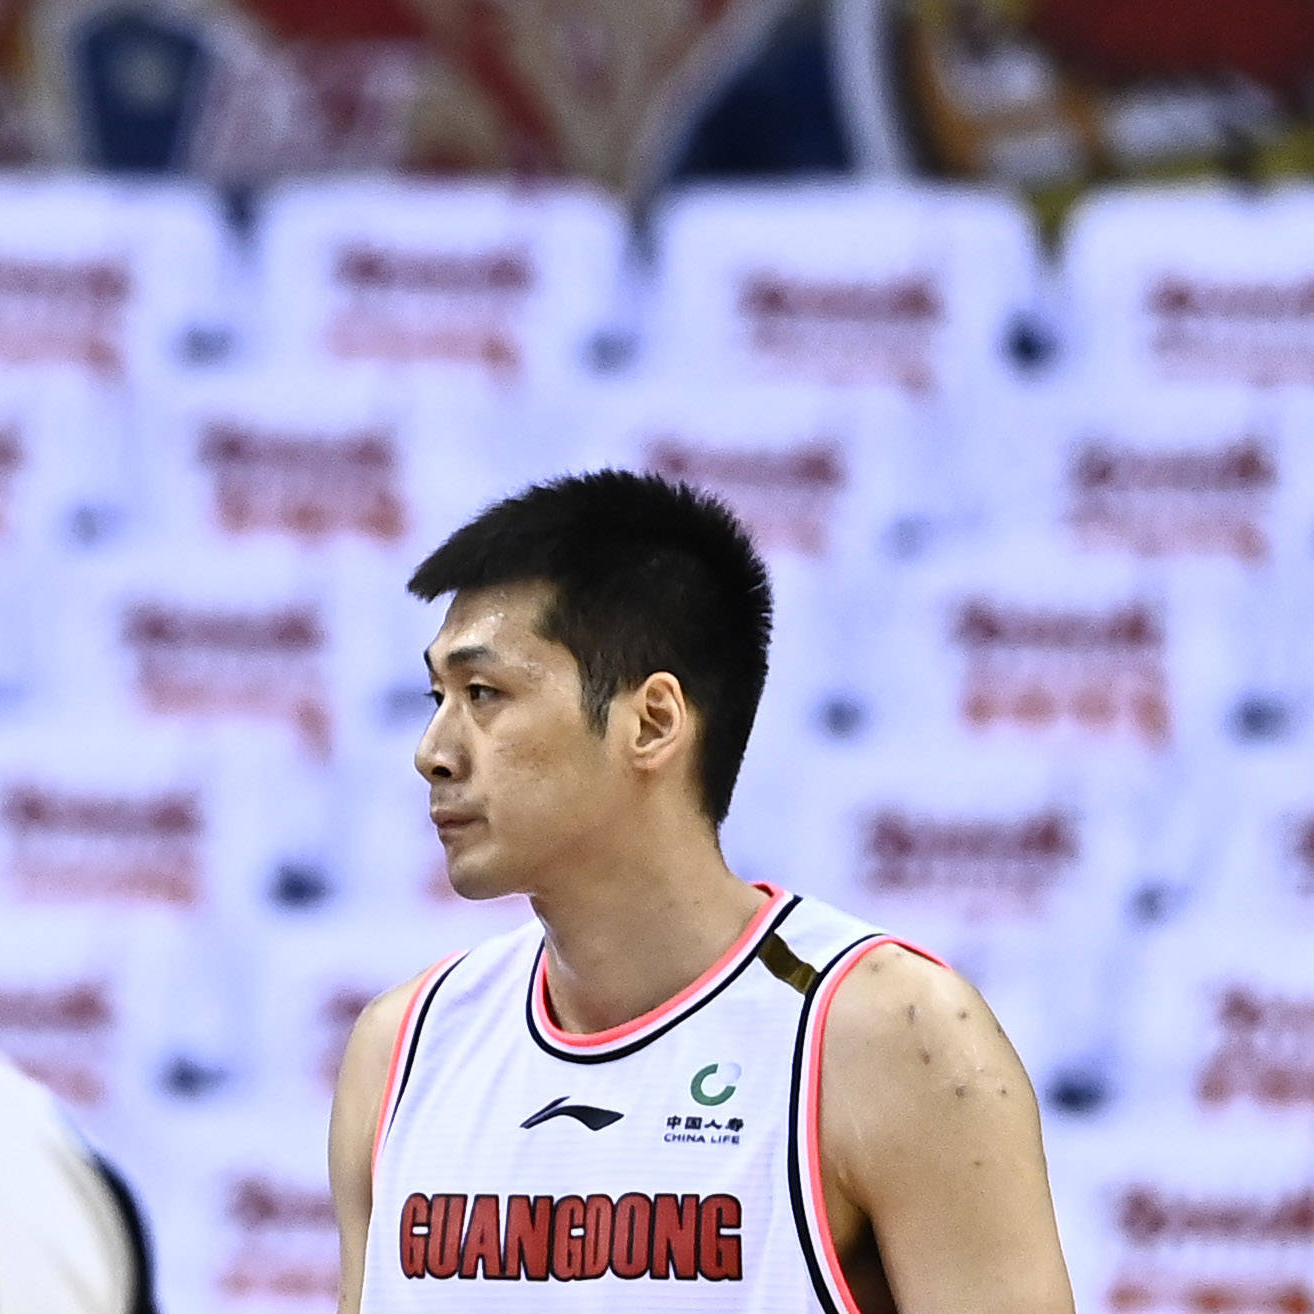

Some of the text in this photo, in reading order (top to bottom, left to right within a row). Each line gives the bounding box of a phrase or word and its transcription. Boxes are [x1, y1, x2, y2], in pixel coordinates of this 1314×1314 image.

[663, 1133, 740, 1145] CHINA LIFE
[400, 1192, 744, 1282] GUANGDONG
